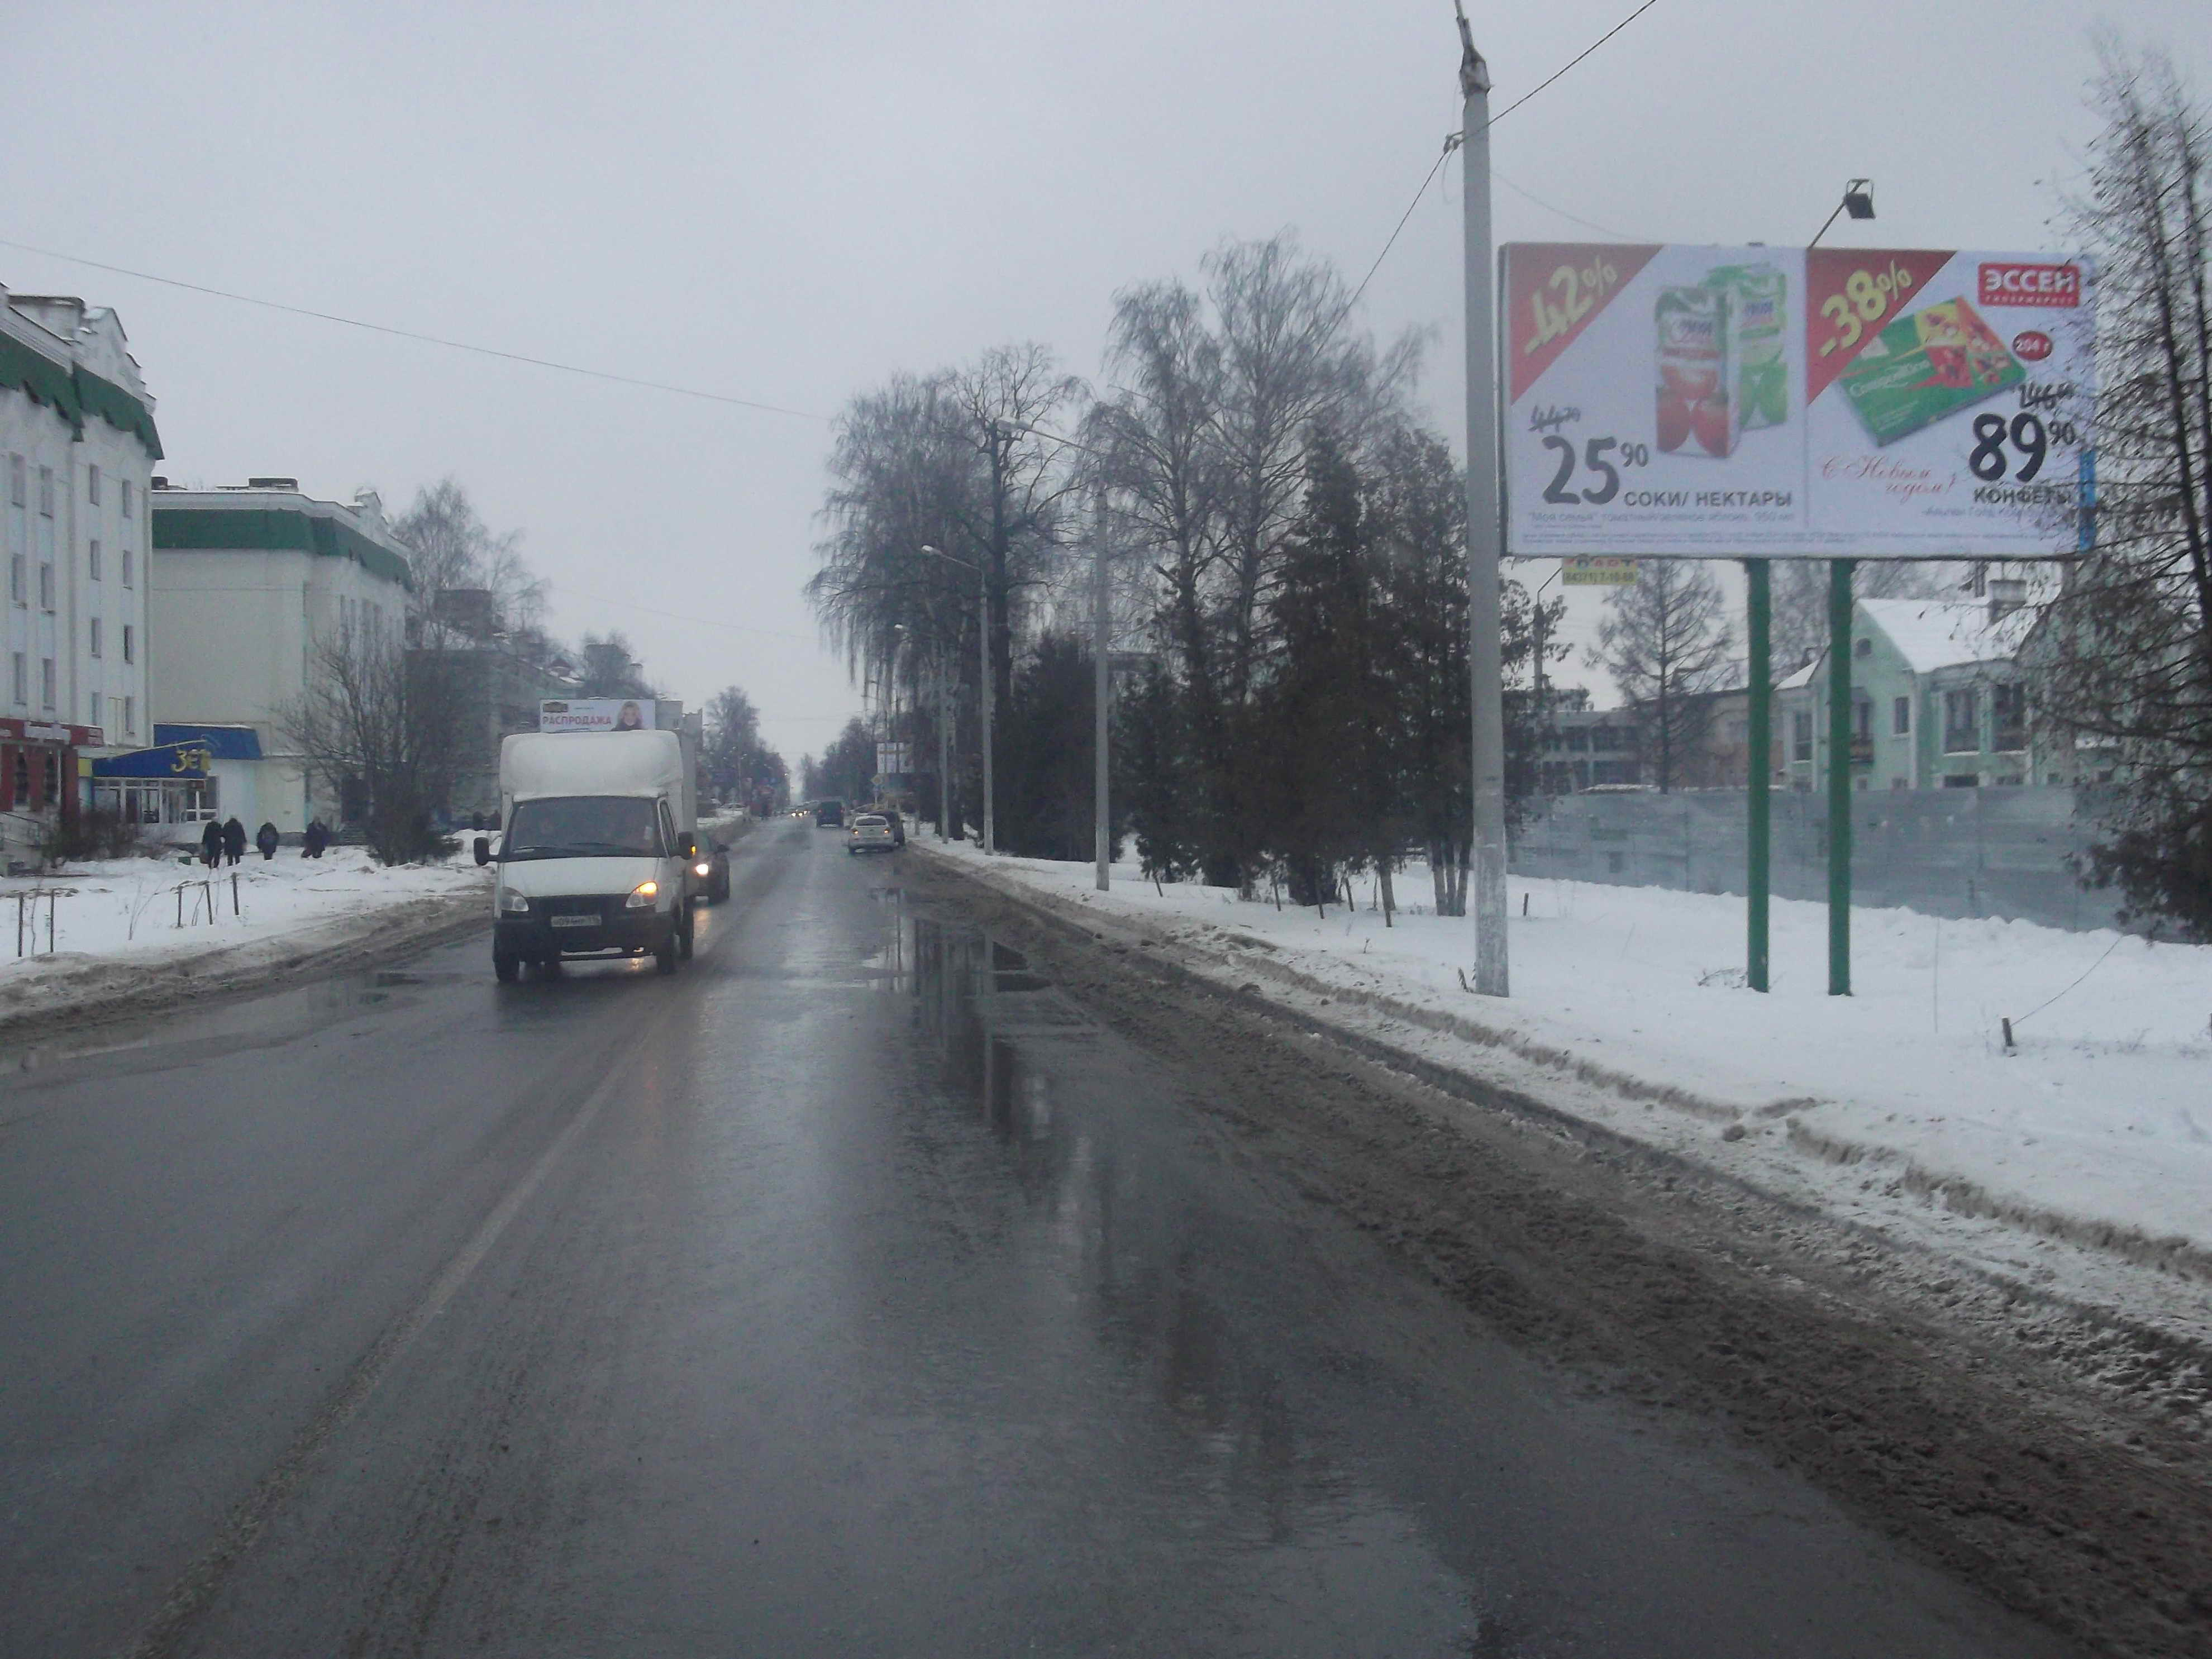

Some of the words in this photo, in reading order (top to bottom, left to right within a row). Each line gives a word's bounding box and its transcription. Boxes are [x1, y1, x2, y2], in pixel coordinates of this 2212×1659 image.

[1985, 268, 2075, 293] ЭССЕН
[1524, 255, 1618, 354] -42%
[1819, 259, 1913, 358] -38%
[1696, 492, 1792, 507] НЕКТАРЫ
[542, 716, 612, 726] РАСПРОДАЖА
